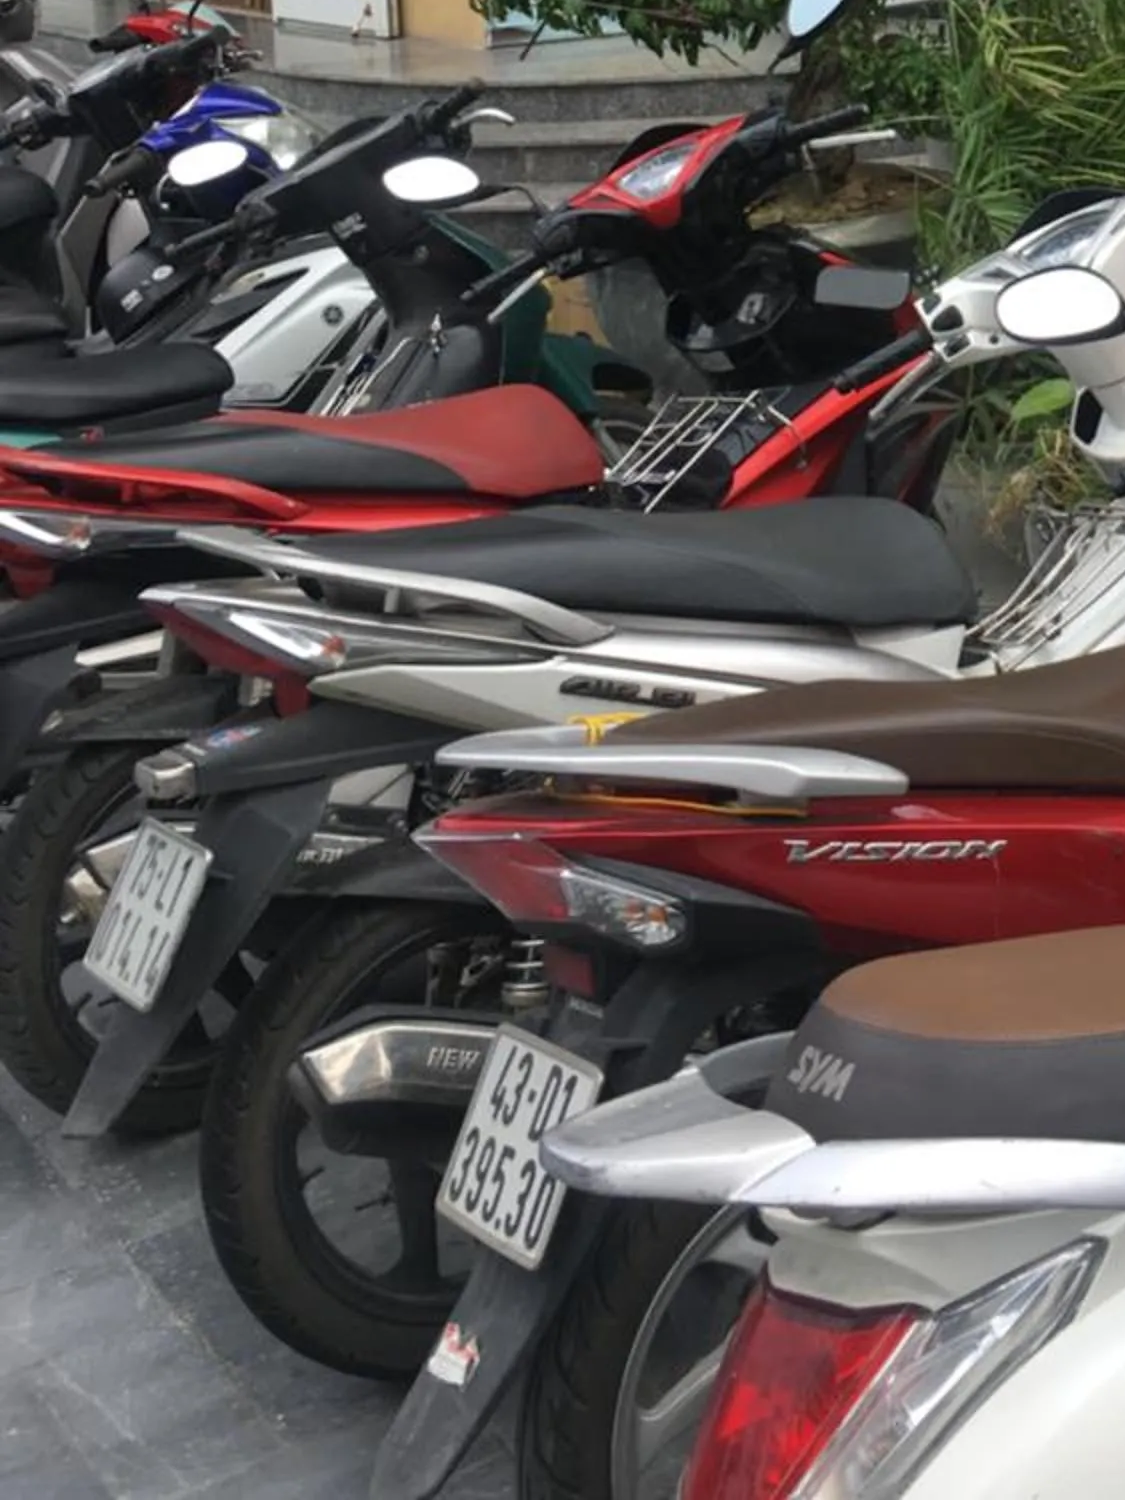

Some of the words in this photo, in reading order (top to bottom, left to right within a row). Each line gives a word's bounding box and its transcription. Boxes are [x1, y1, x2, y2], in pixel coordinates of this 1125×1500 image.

[783, 839, 1008, 864] VISION
[787, 1044, 856, 1102] SYM
[450, 1126, 556, 1251] 395.30
